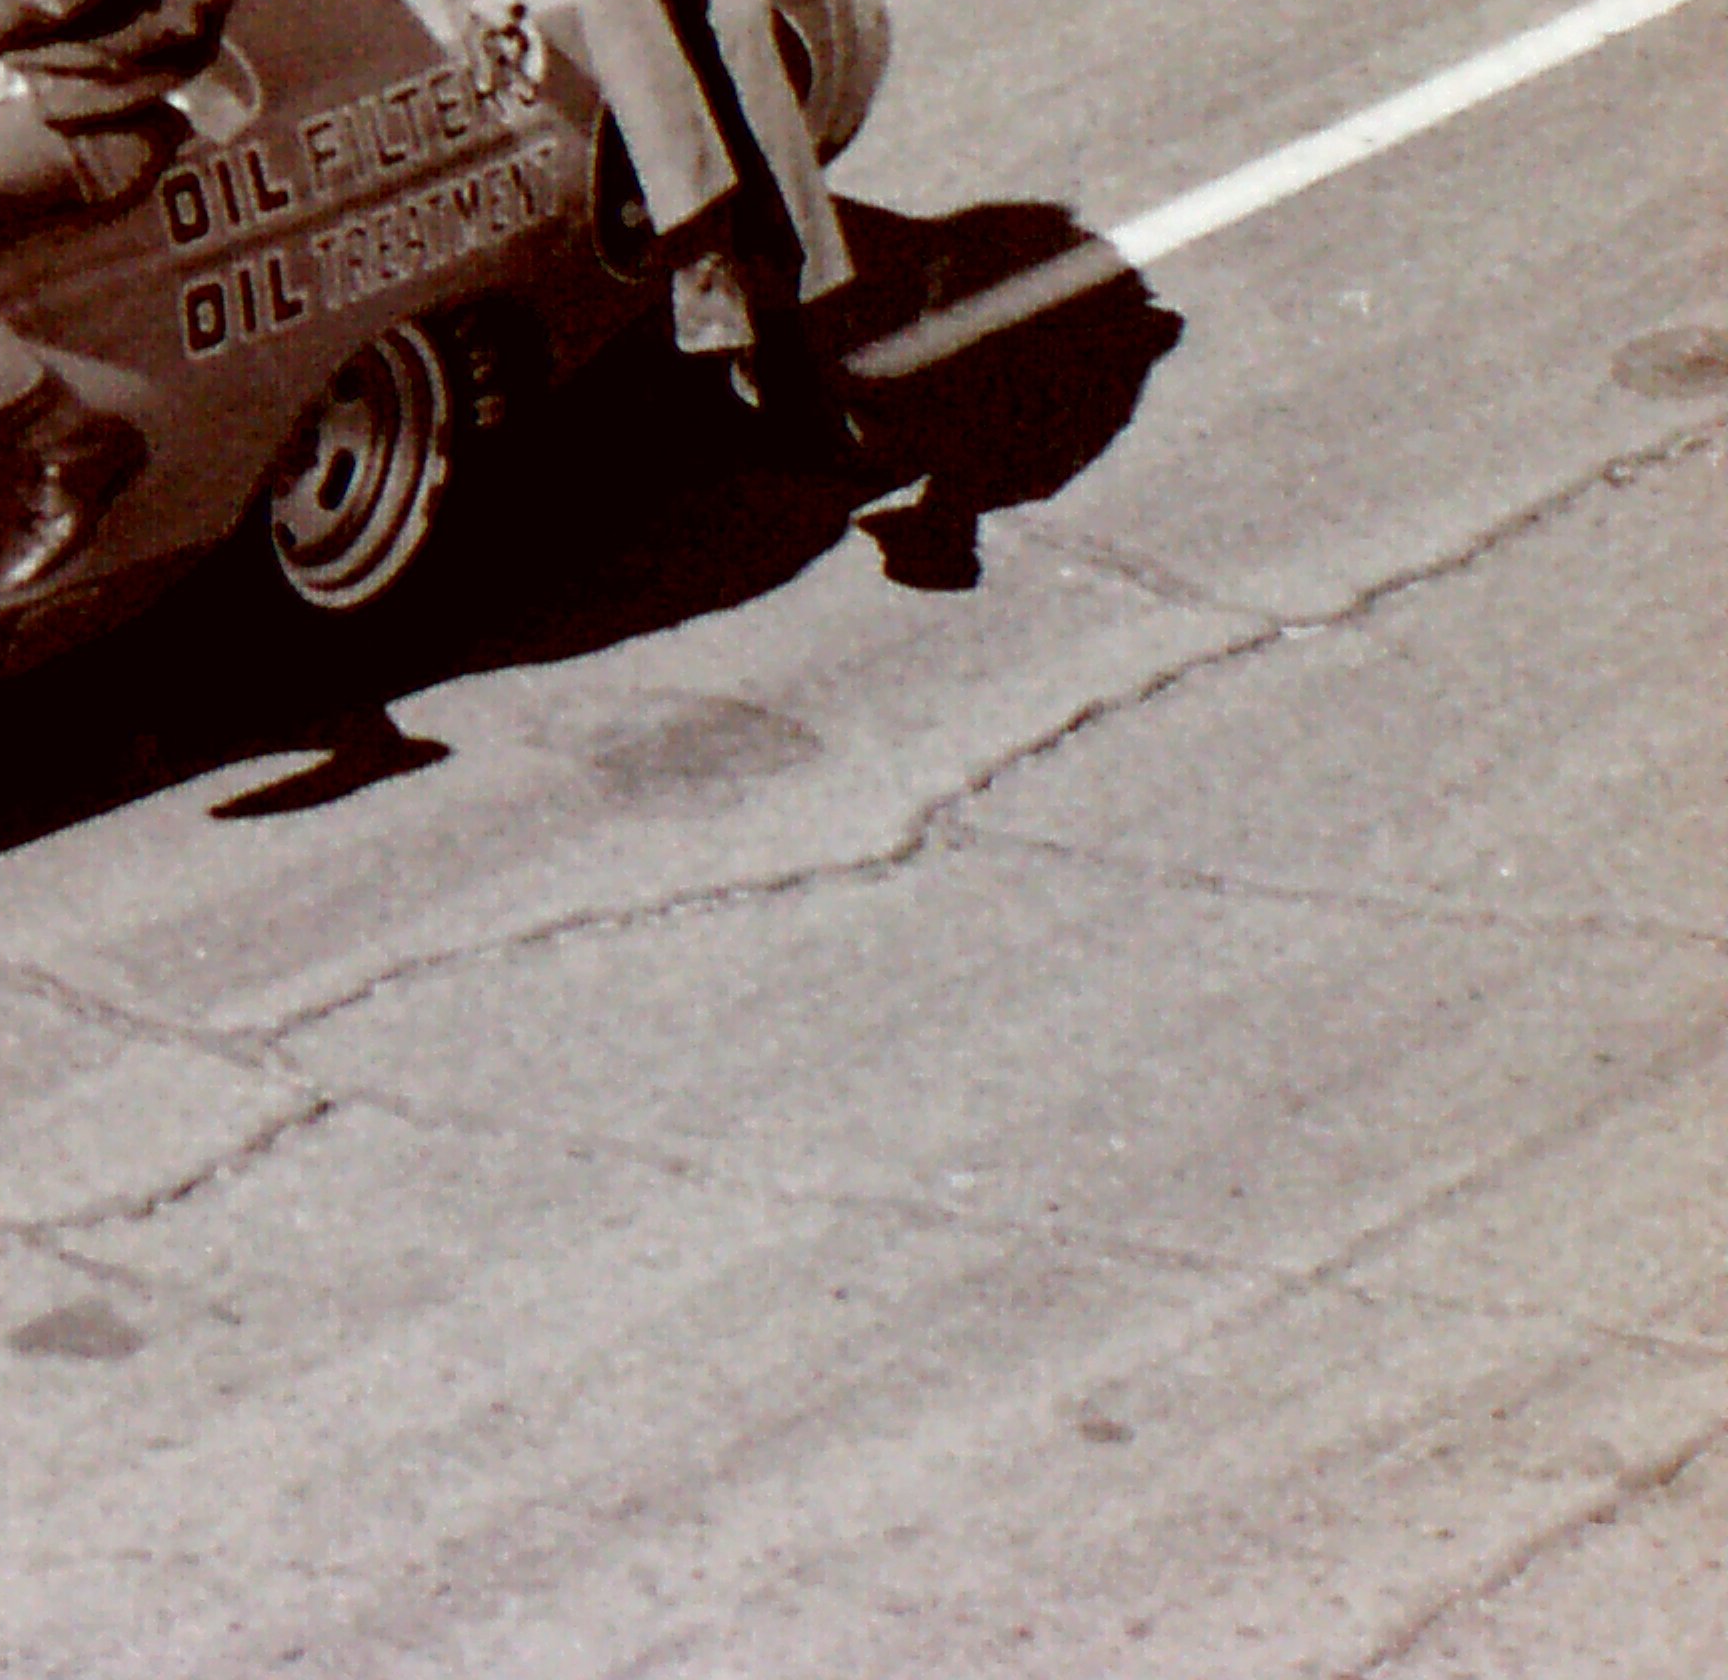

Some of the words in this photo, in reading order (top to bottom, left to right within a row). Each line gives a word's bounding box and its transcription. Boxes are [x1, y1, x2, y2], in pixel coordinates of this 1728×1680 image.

[159, 142, 292, 253] OIL
[182, 247, 308, 357] OIL
[311, 139, 556, 310] TREATMENT
